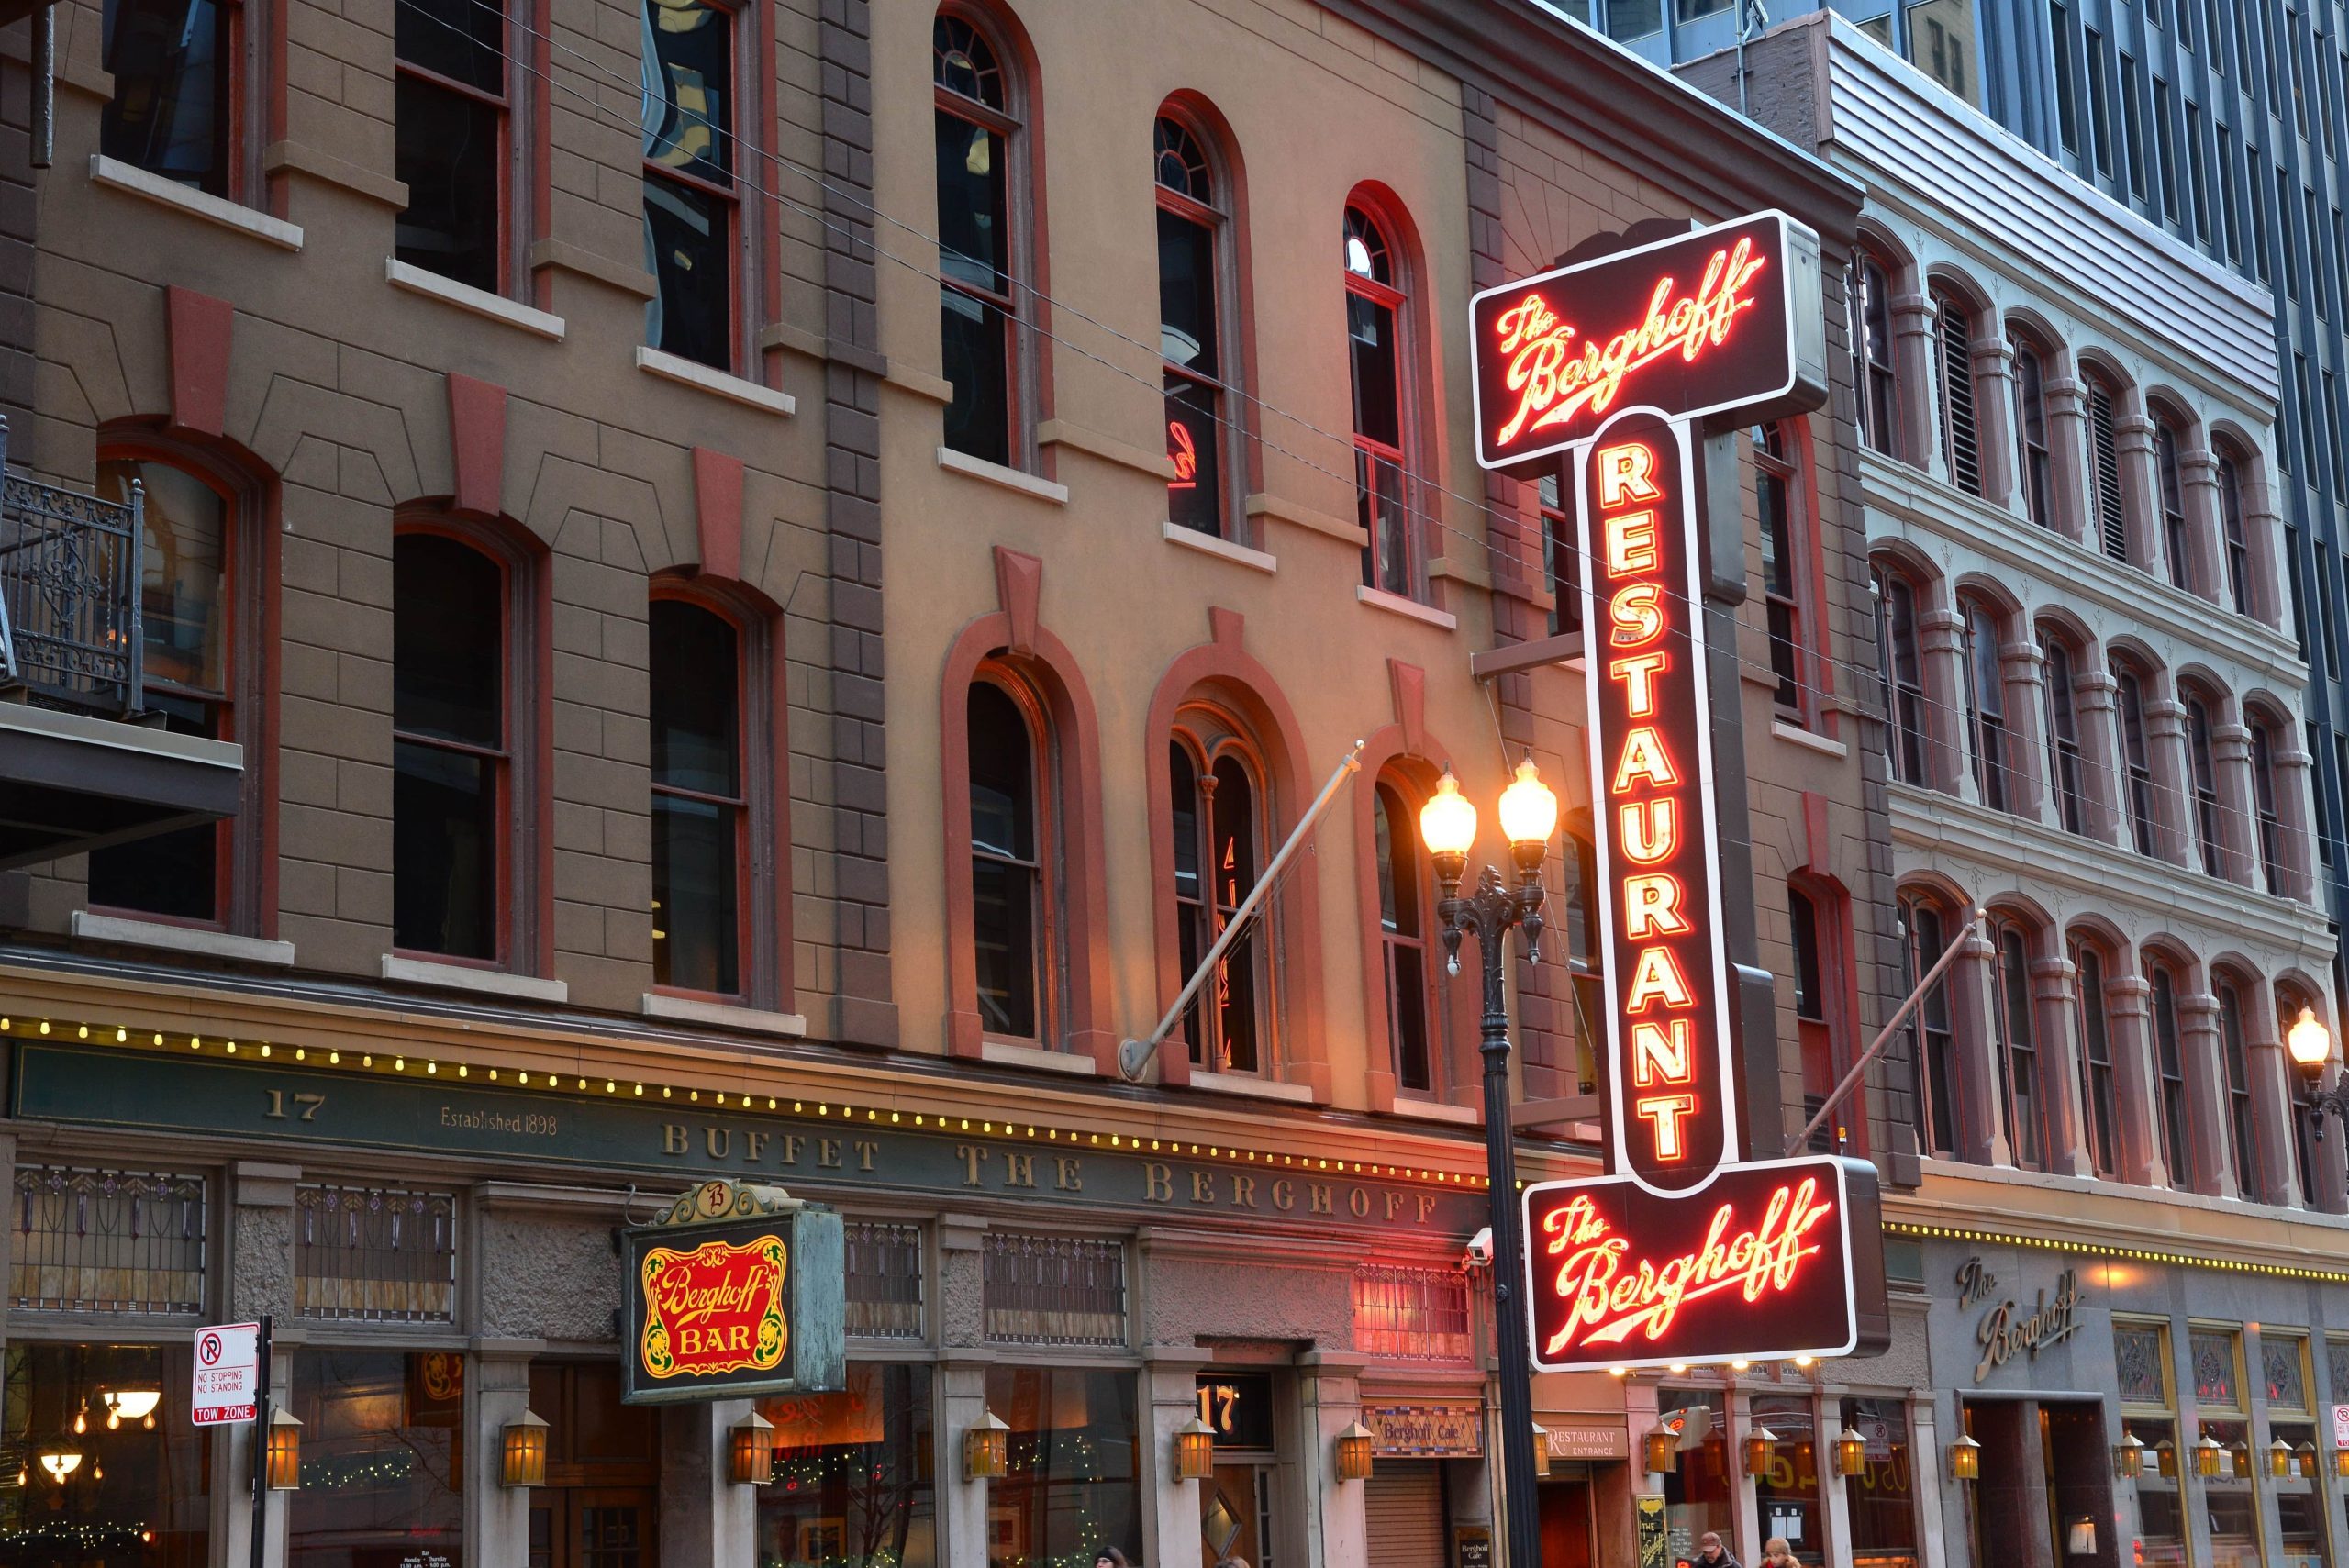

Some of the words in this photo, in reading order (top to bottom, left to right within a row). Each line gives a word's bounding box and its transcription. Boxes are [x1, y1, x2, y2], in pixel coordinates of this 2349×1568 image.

[1497, 293, 1560, 355] The
[1497, 236, 1765, 448] Berghoff
[1598, 442, 1695, 1162] RESTAURANT
[264, 1089, 326, 1122] 17
[440, 1106, 521, 1134] Established
[525, 1113, 558, 1136] 1898
[661, 1124, 878, 1172] BUFFET
[956, 1144, 1083, 1190] THE
[1141, 1162, 1436, 1224] BERGHOFF
[1543, 1194, 1611, 1255] The
[1544, 1176, 1832, 1356] Berghoff
[1956, 1255, 1998, 1309] The
[660, 1262, 770, 1329] Berghoff
[678, 1325, 751, 1355] BAR
[1975, 1268, 2086, 1383] Berghoff
[197, 1373, 207, 1383] NO
[211, 1370, 242, 1382] STOPPING
[197, 1384, 207, 1394] NO
[211, 1381, 242, 1393] STANDING
[197, 1407, 218, 1421] TOW
[223, 1406, 250, 1419] ZONE
[1197, 1384, 1235, 1431] 17
[1384, 1422, 1431, 1443] Berghoff
[1547, 1428, 1615, 1456] RESTAURANT
[1572, 1447, 1613, 1456] ENTRANCE
